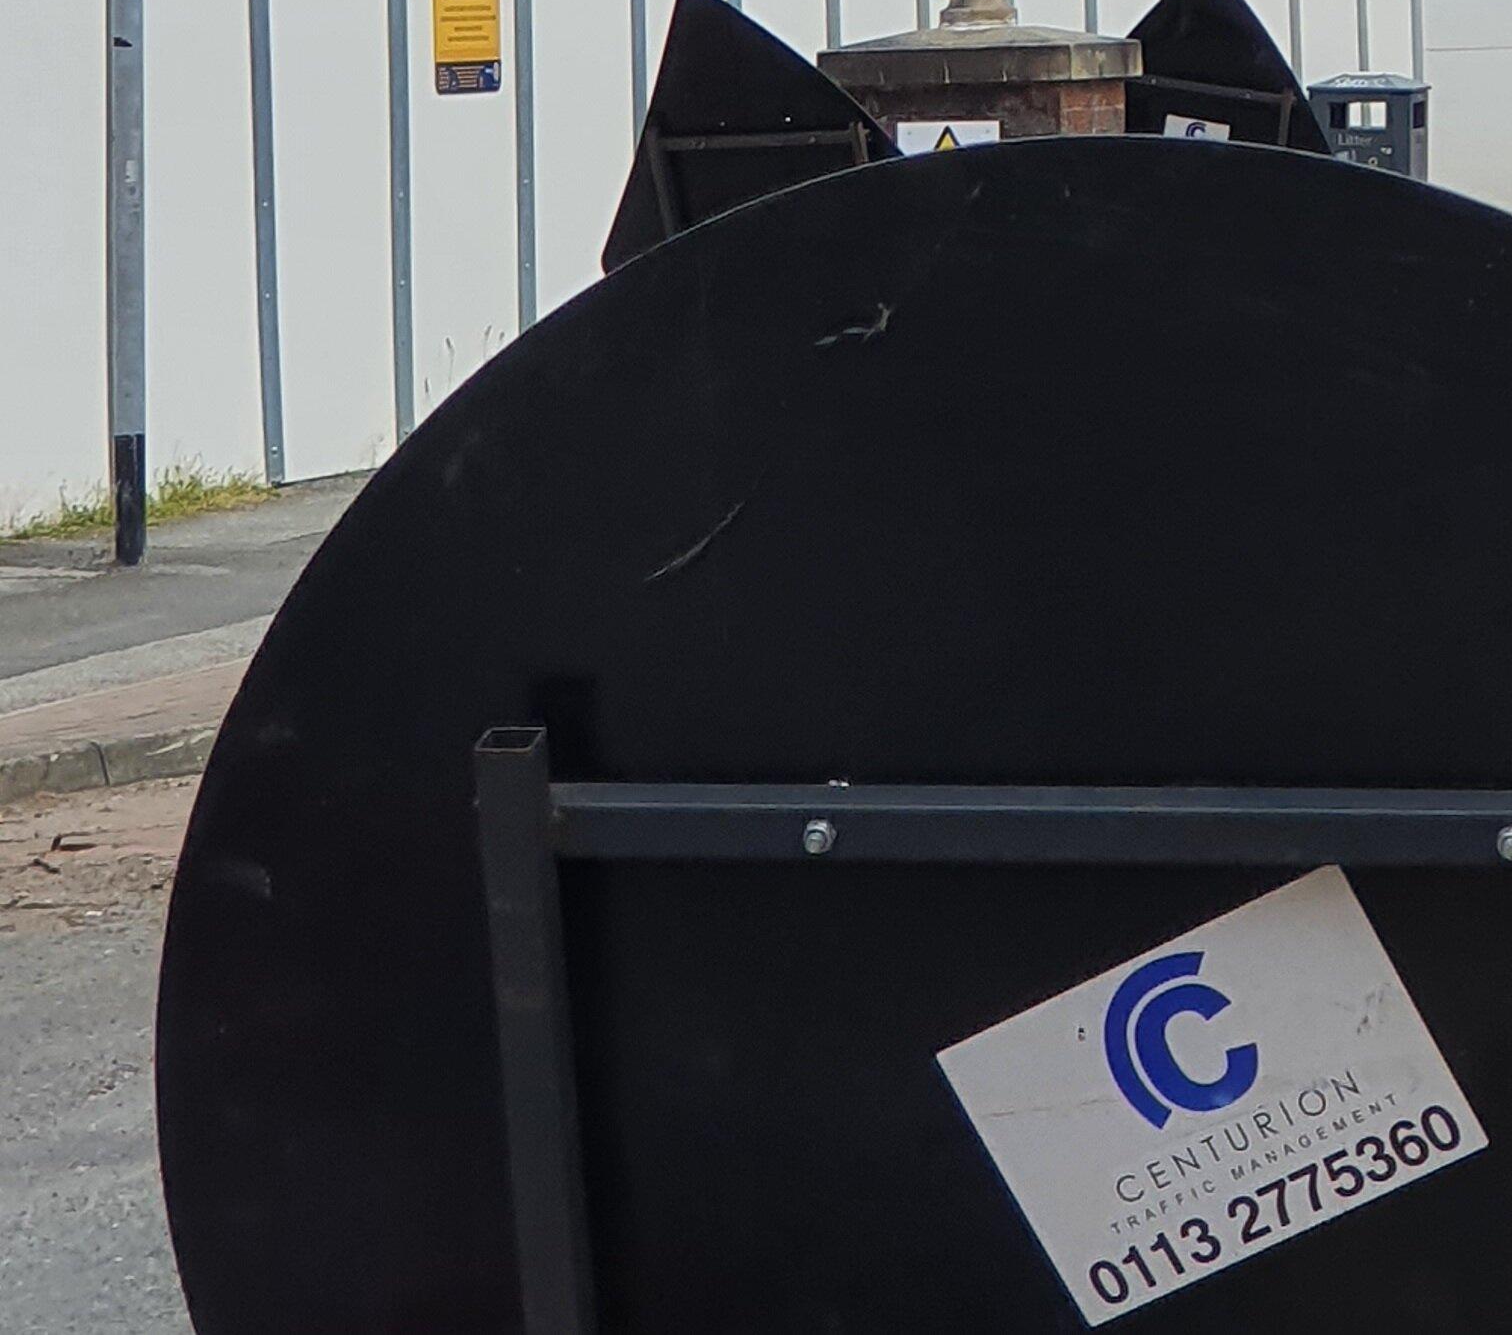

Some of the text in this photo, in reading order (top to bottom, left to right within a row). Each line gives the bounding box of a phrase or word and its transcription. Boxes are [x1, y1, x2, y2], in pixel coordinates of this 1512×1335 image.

[1088, 1104, 1461, 1305] 0113 2775360
[1110, 1093, 1399, 1235] TRAFFIC MANAGEMENT
[1115, 1070, 1361, 1202] CENTURION
